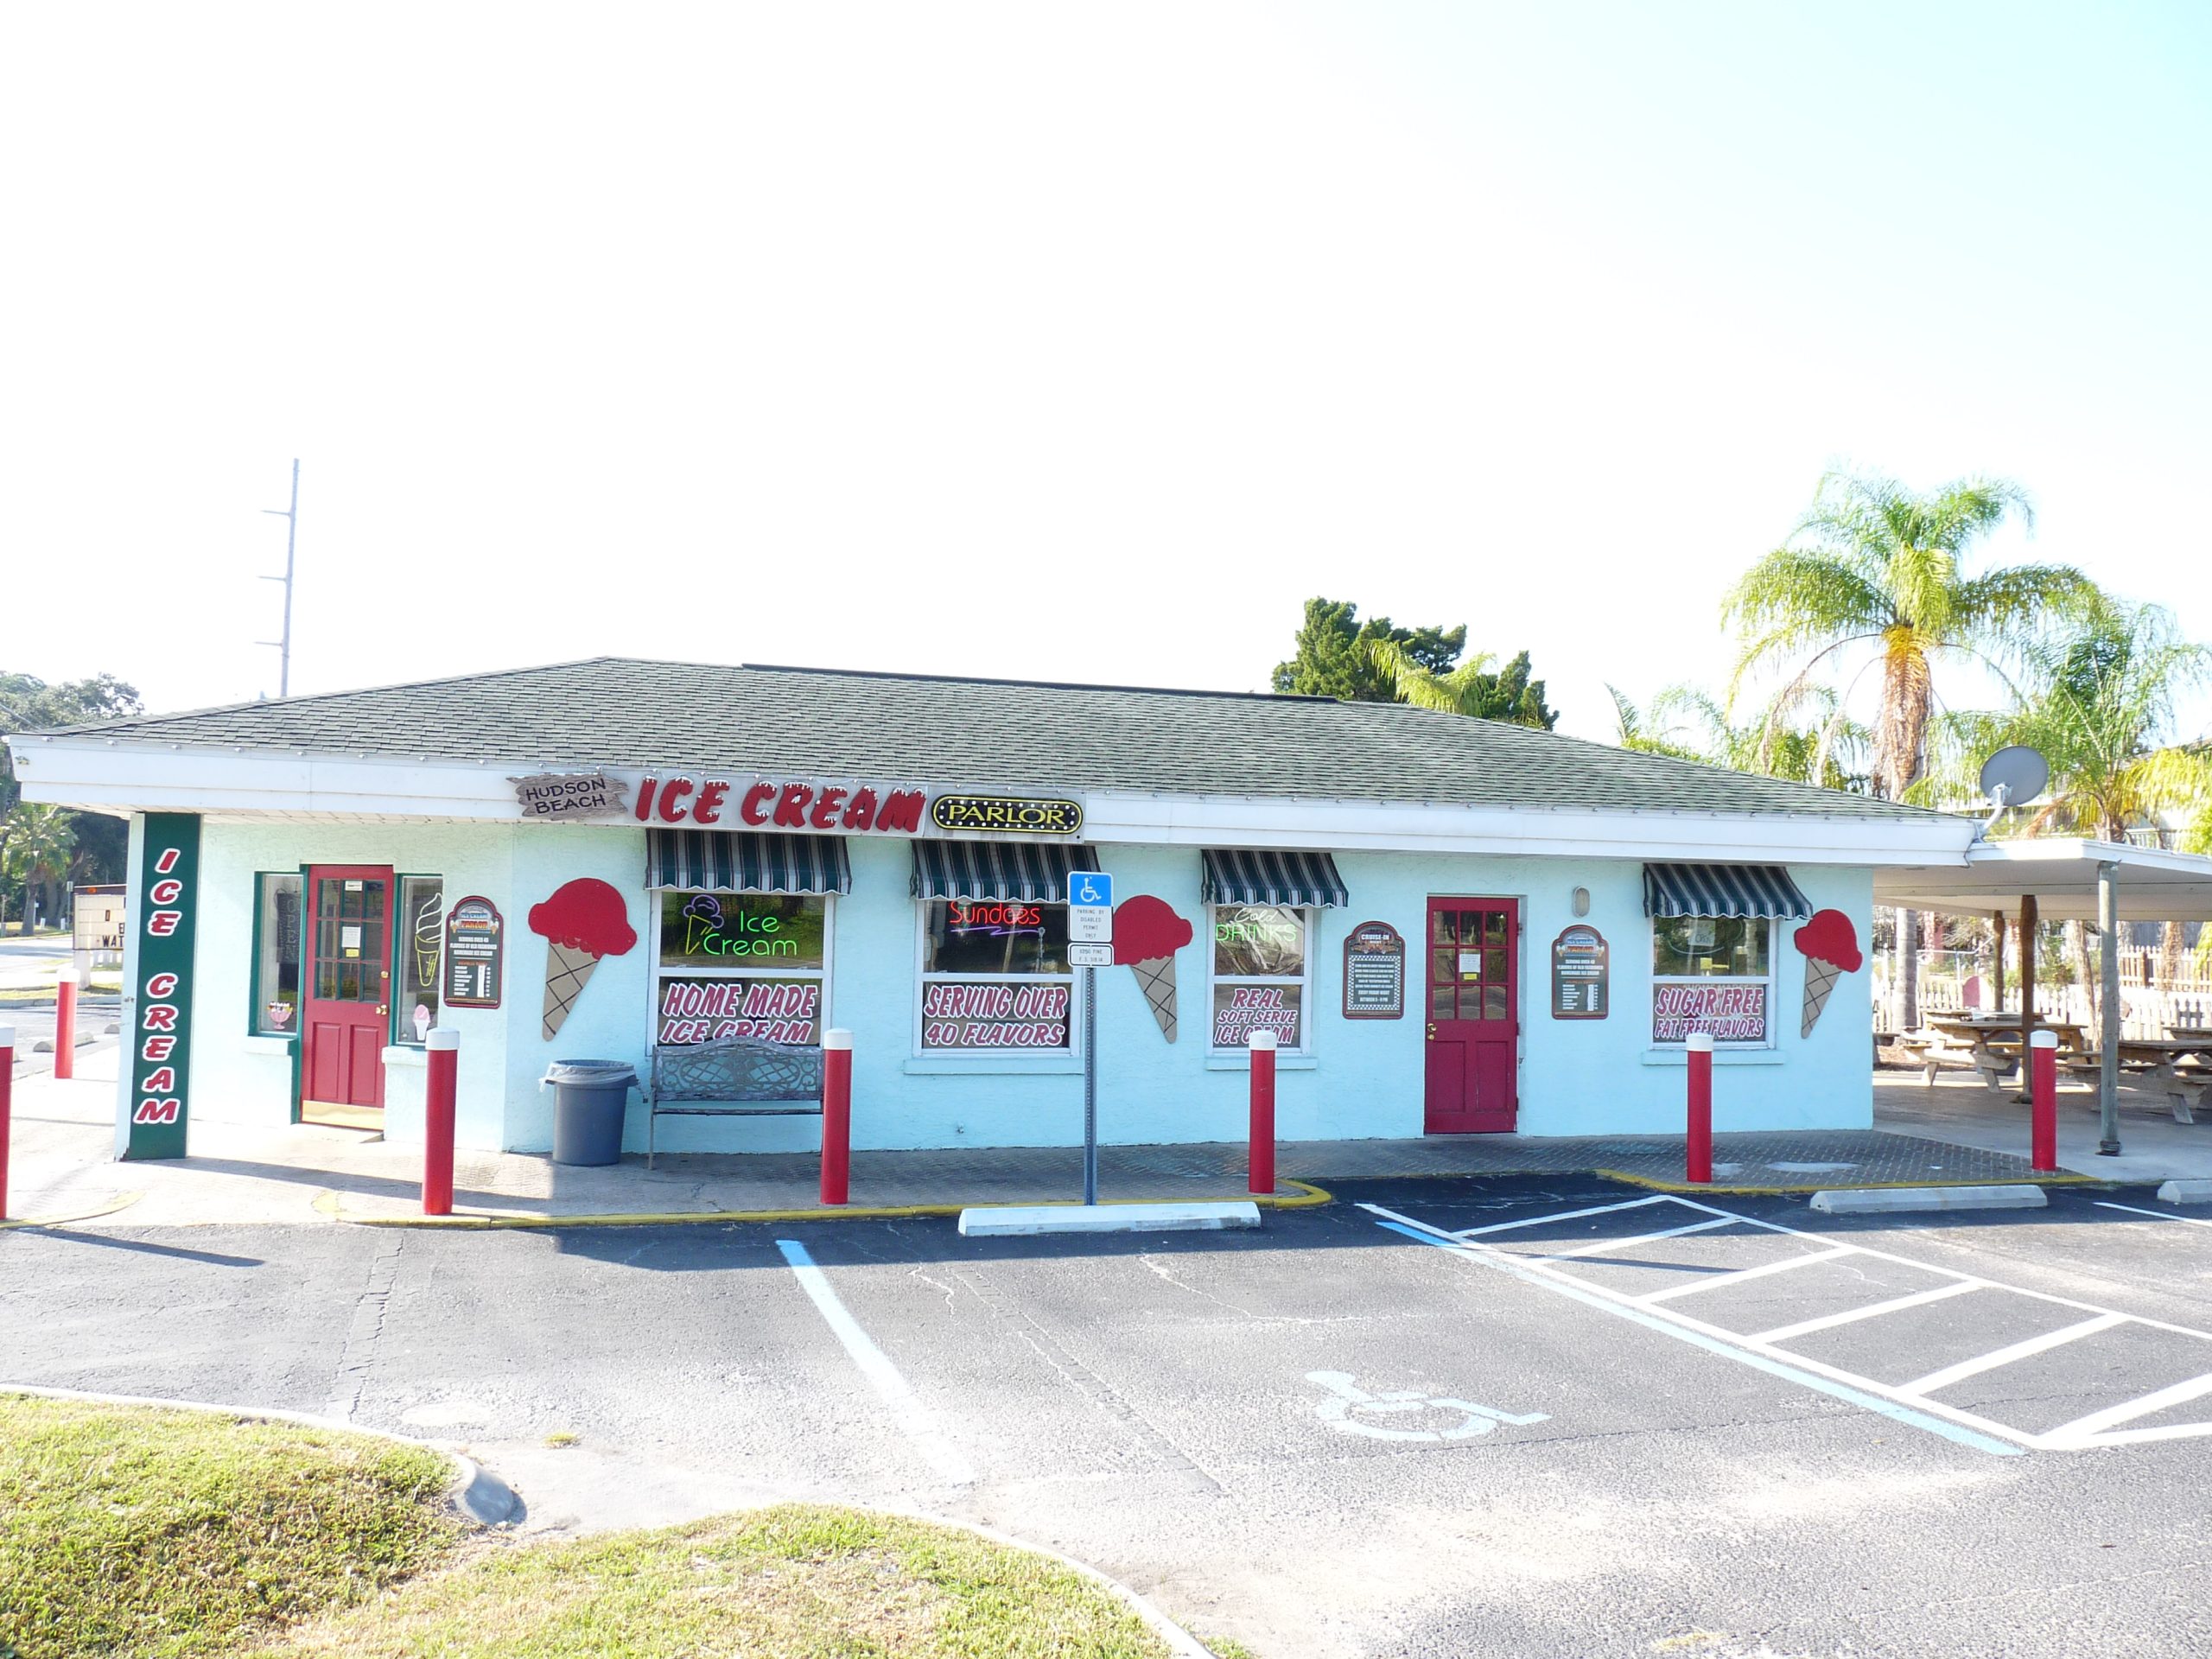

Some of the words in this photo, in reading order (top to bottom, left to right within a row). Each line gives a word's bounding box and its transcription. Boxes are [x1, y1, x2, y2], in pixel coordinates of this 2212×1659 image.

[525, 778, 607, 801] HUDSON
[534, 793, 607, 814] BEACH
[635, 775, 731, 824] ICE
[741, 779, 927, 833] CREAM
[949, 804, 1065, 825] PARLOR
[147, 848, 182, 937] ICE
[740, 910, 780, 932] Ice
[949, 900, 1042, 925] Sundaes
[1234, 907, 1277, 923] Cold
[703, 933, 798, 956] Cream
[1215, 923, 1298, 943] DRINKS
[662, 982, 742, 1018] HOME
[741, 983, 817, 1018] MADE
[924, 985, 1013, 1018] SERVING
[1014, 986, 1068, 1019] OVER
[1231, 988, 1284, 1009] REAL
[1655, 987, 1718, 1016] SUGAR
[1719, 988, 1764, 1016] FREE
[1217, 1009, 1253, 1024] SOFT
[1254, 1009, 1298, 1024] SERVE
[659, 1020, 710, 1043] ICE
[713, 1020, 814, 1043] CREAM
[926, 1022, 959, 1045] 40
[961, 1023, 1065, 1046] FLAVORS
[1214, 1025, 1241, 1044] ICE
[1655, 1018, 1679, 1039] FAT
[1679, 1018, 1711, 1036] FREE
[1711, 1018, 1764, 1038] FLAVORS
[133, 972, 181, 1125] CREAM
